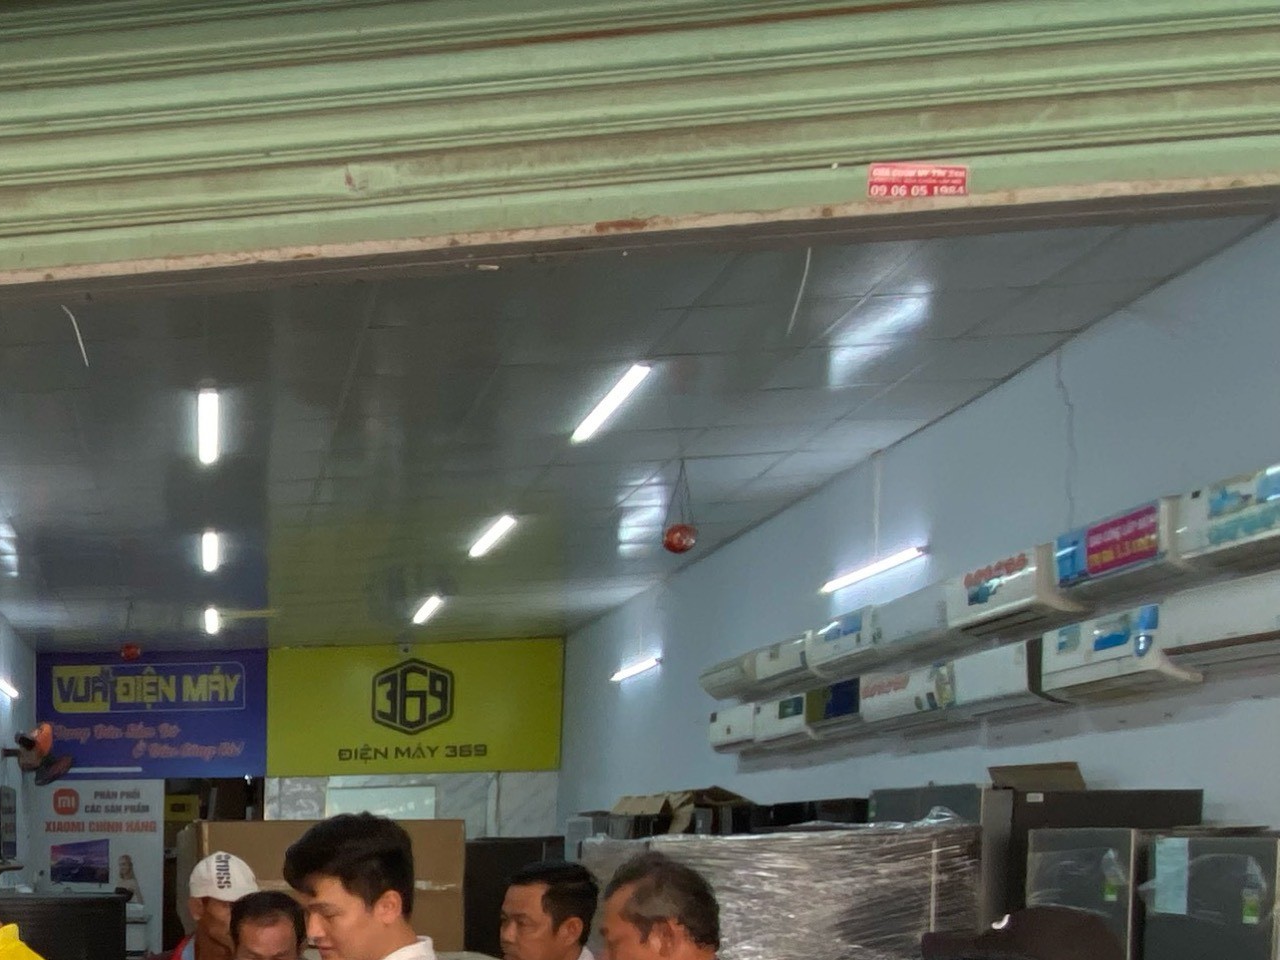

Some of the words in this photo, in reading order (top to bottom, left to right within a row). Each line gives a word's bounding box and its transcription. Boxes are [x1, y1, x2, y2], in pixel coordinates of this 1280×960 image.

[870, 185, 887, 196] 09
[891, 185, 907, 196] 06
[911, 185, 928, 196] 05
[115, 666, 176, 709] ĐIỆN
[183, 665, 241, 702] MÁY
[377, 664, 449, 730] 369
[338, 743, 388, 765] ĐIỆN
[394, 742, 439, 759] MÁY
[445, 743, 487, 758] 369
[45, 821, 85, 833] XIAOMI
